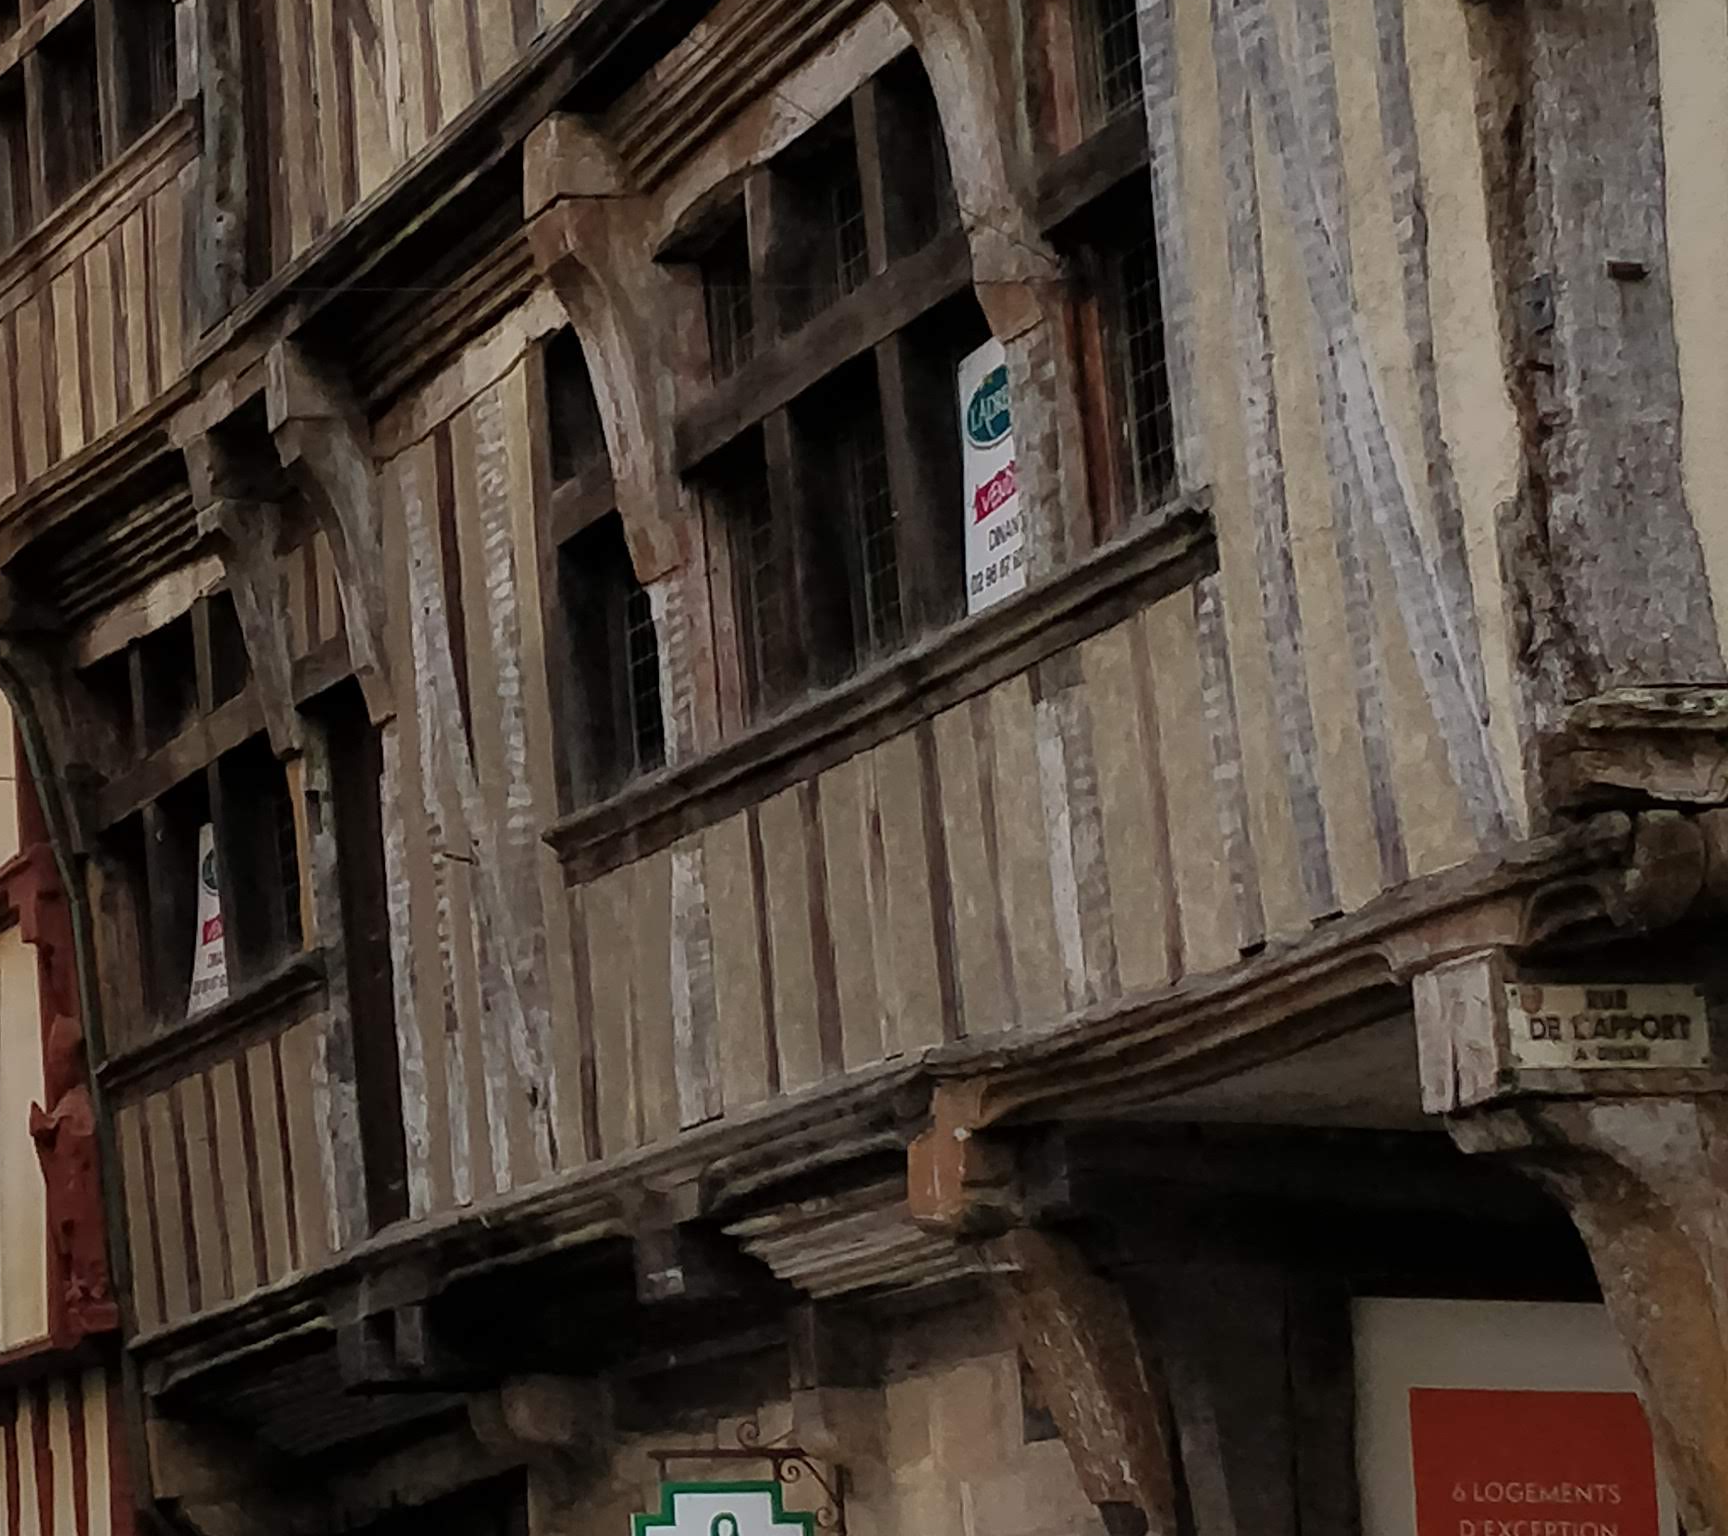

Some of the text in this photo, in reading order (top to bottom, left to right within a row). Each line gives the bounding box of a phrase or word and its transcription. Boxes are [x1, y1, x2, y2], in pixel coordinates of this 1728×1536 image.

[1529, 1017, 1562, 1041] DE
[1452, 1482, 1622, 1505] 6 LOGEMENTS
